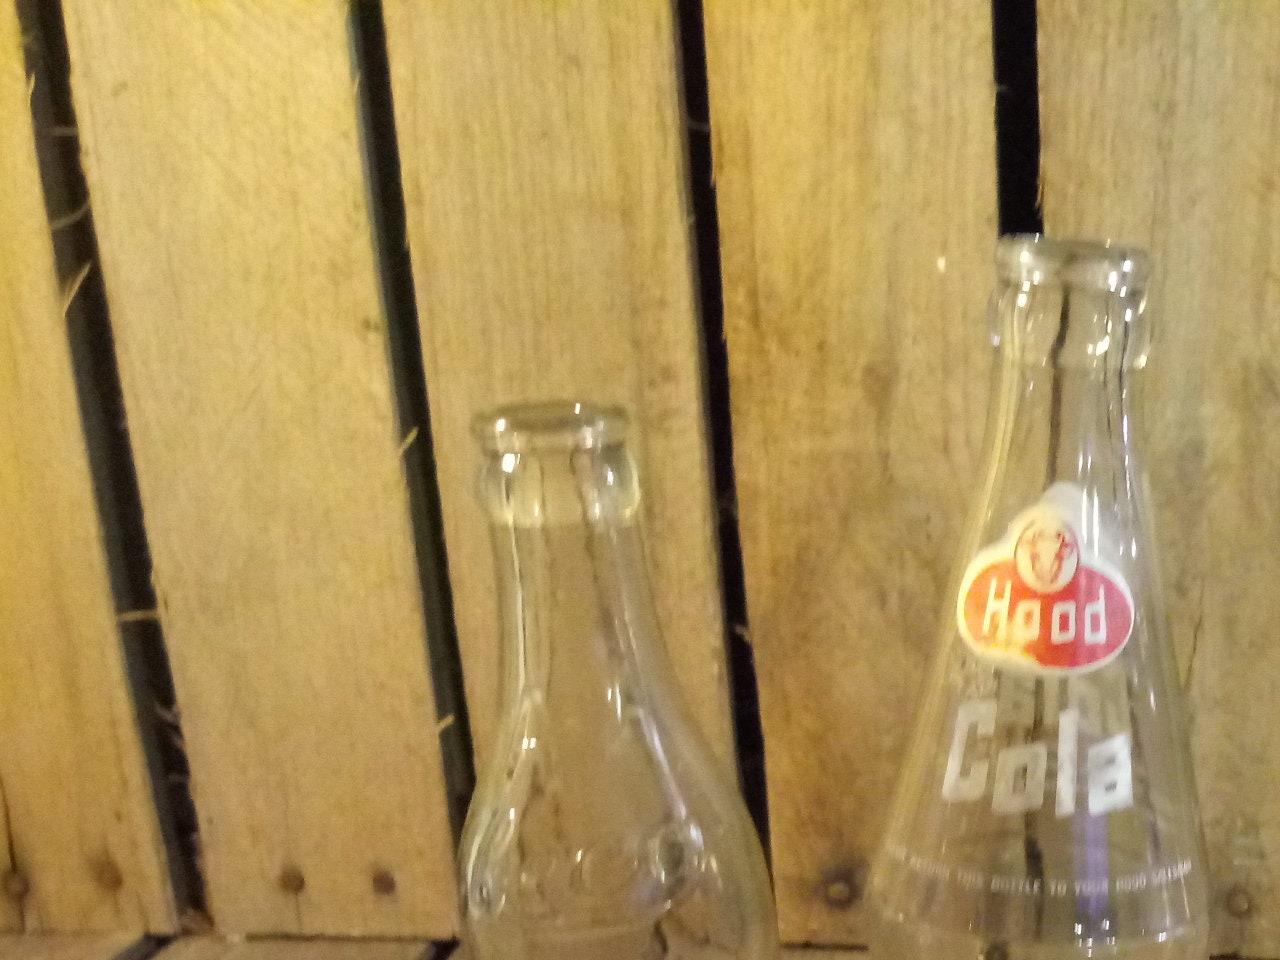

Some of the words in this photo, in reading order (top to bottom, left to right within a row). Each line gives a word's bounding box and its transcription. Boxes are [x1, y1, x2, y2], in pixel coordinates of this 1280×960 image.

[983, 576, 1108, 645] Hood
[942, 700, 1134, 816] Cola
[991, 873, 1042, 895] BOTTLE
[1050, 878, 1068, 896] TO
